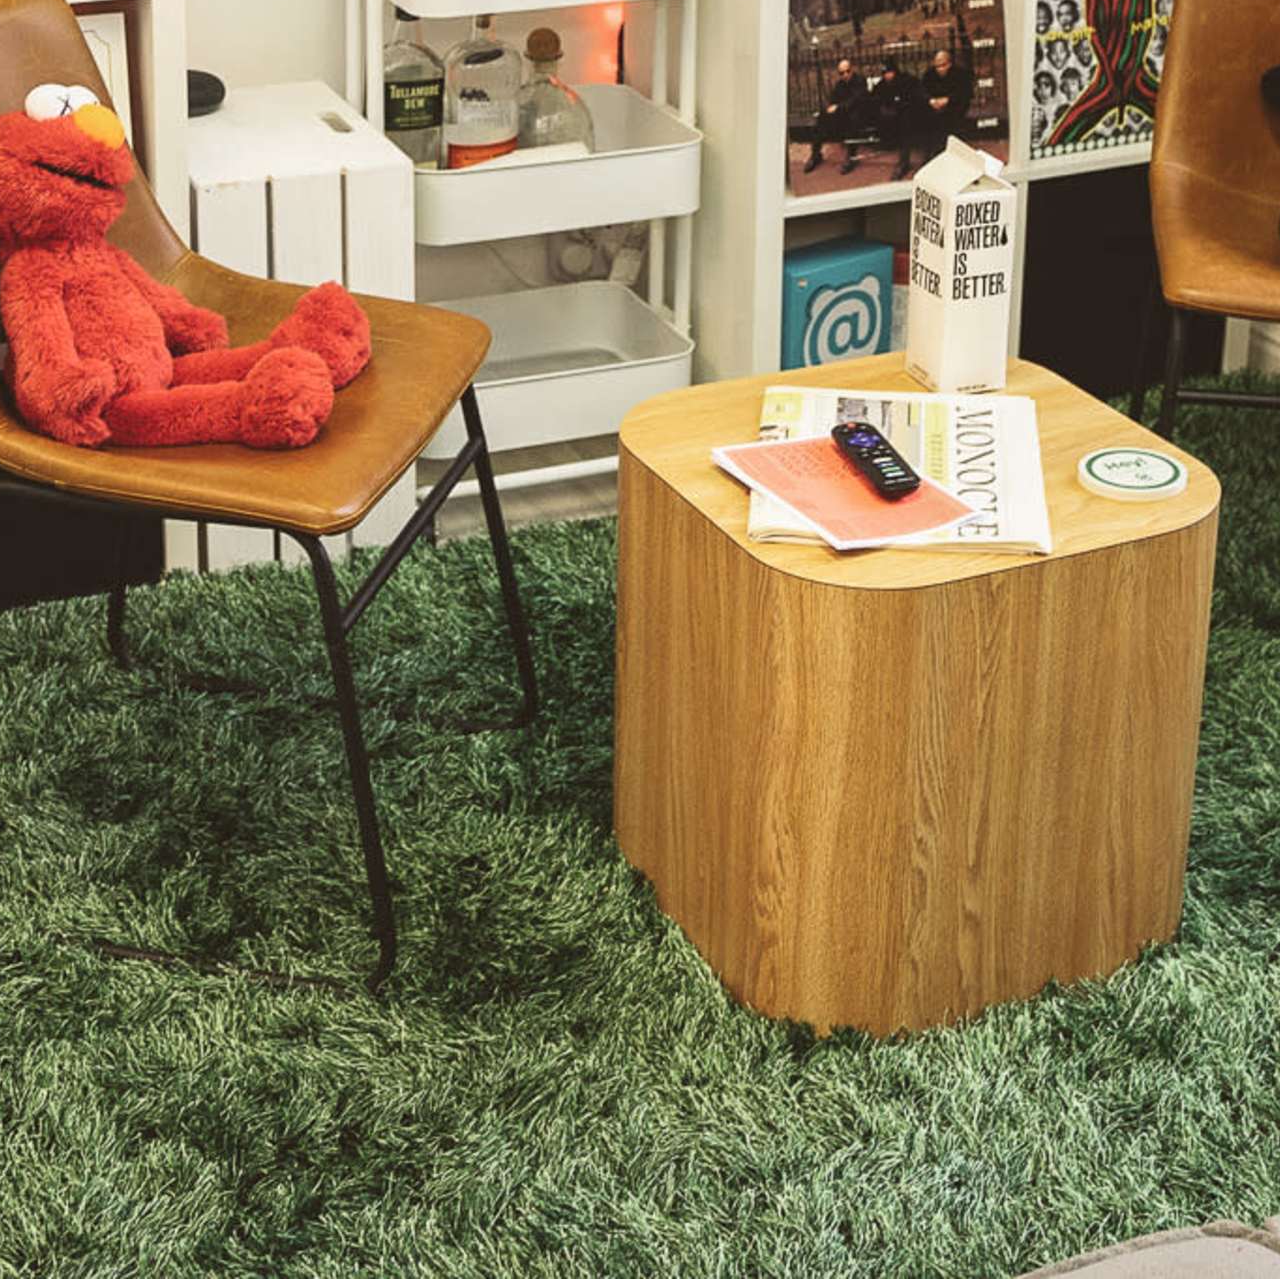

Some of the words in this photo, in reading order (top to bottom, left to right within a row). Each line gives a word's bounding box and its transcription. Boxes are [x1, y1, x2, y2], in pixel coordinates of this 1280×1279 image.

[972, 38, 996, 48] WITH
[389, 84, 441, 99] TULLAMORE
[978, 78, 994, 88] THE
[977, 117, 999, 129] KING
[914, 186, 942, 221] BOXED
[954, 200, 1001, 228] BOXED
[913, 210, 941, 248] WATER
[953, 224, 1000, 251] WATER
[952, 252, 968, 276] IS
[951, 271, 1007, 301] BETTER.
